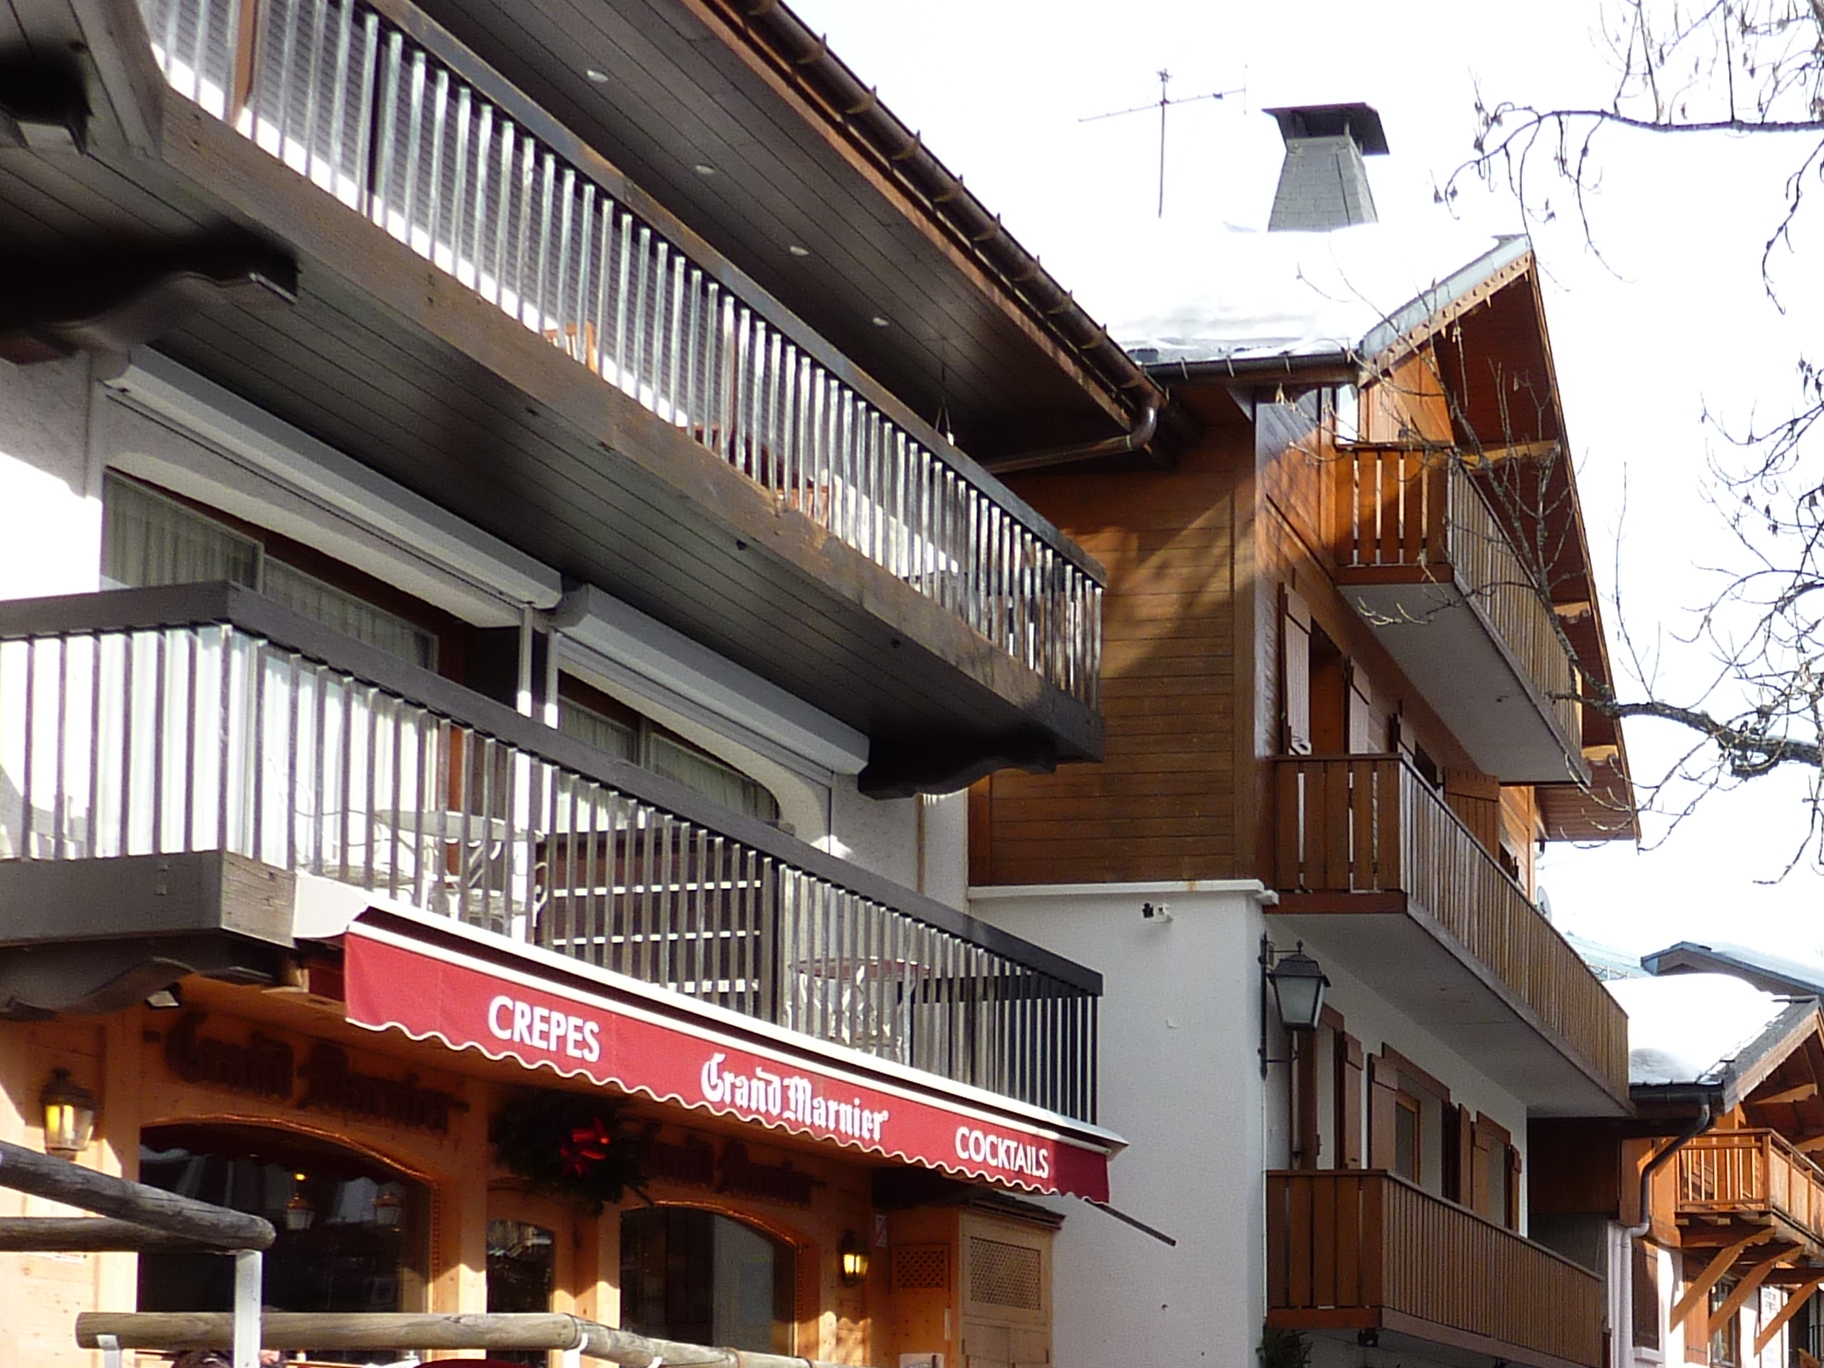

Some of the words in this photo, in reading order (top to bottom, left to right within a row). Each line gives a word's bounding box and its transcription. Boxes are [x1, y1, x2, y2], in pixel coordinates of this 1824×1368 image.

[488, 995, 600, 1063] CREPES
[701, 1052, 782, 1117] Grand
[782, 1075, 889, 1143] Marnier
[954, 1126, 1049, 1179] COCKTAILS
